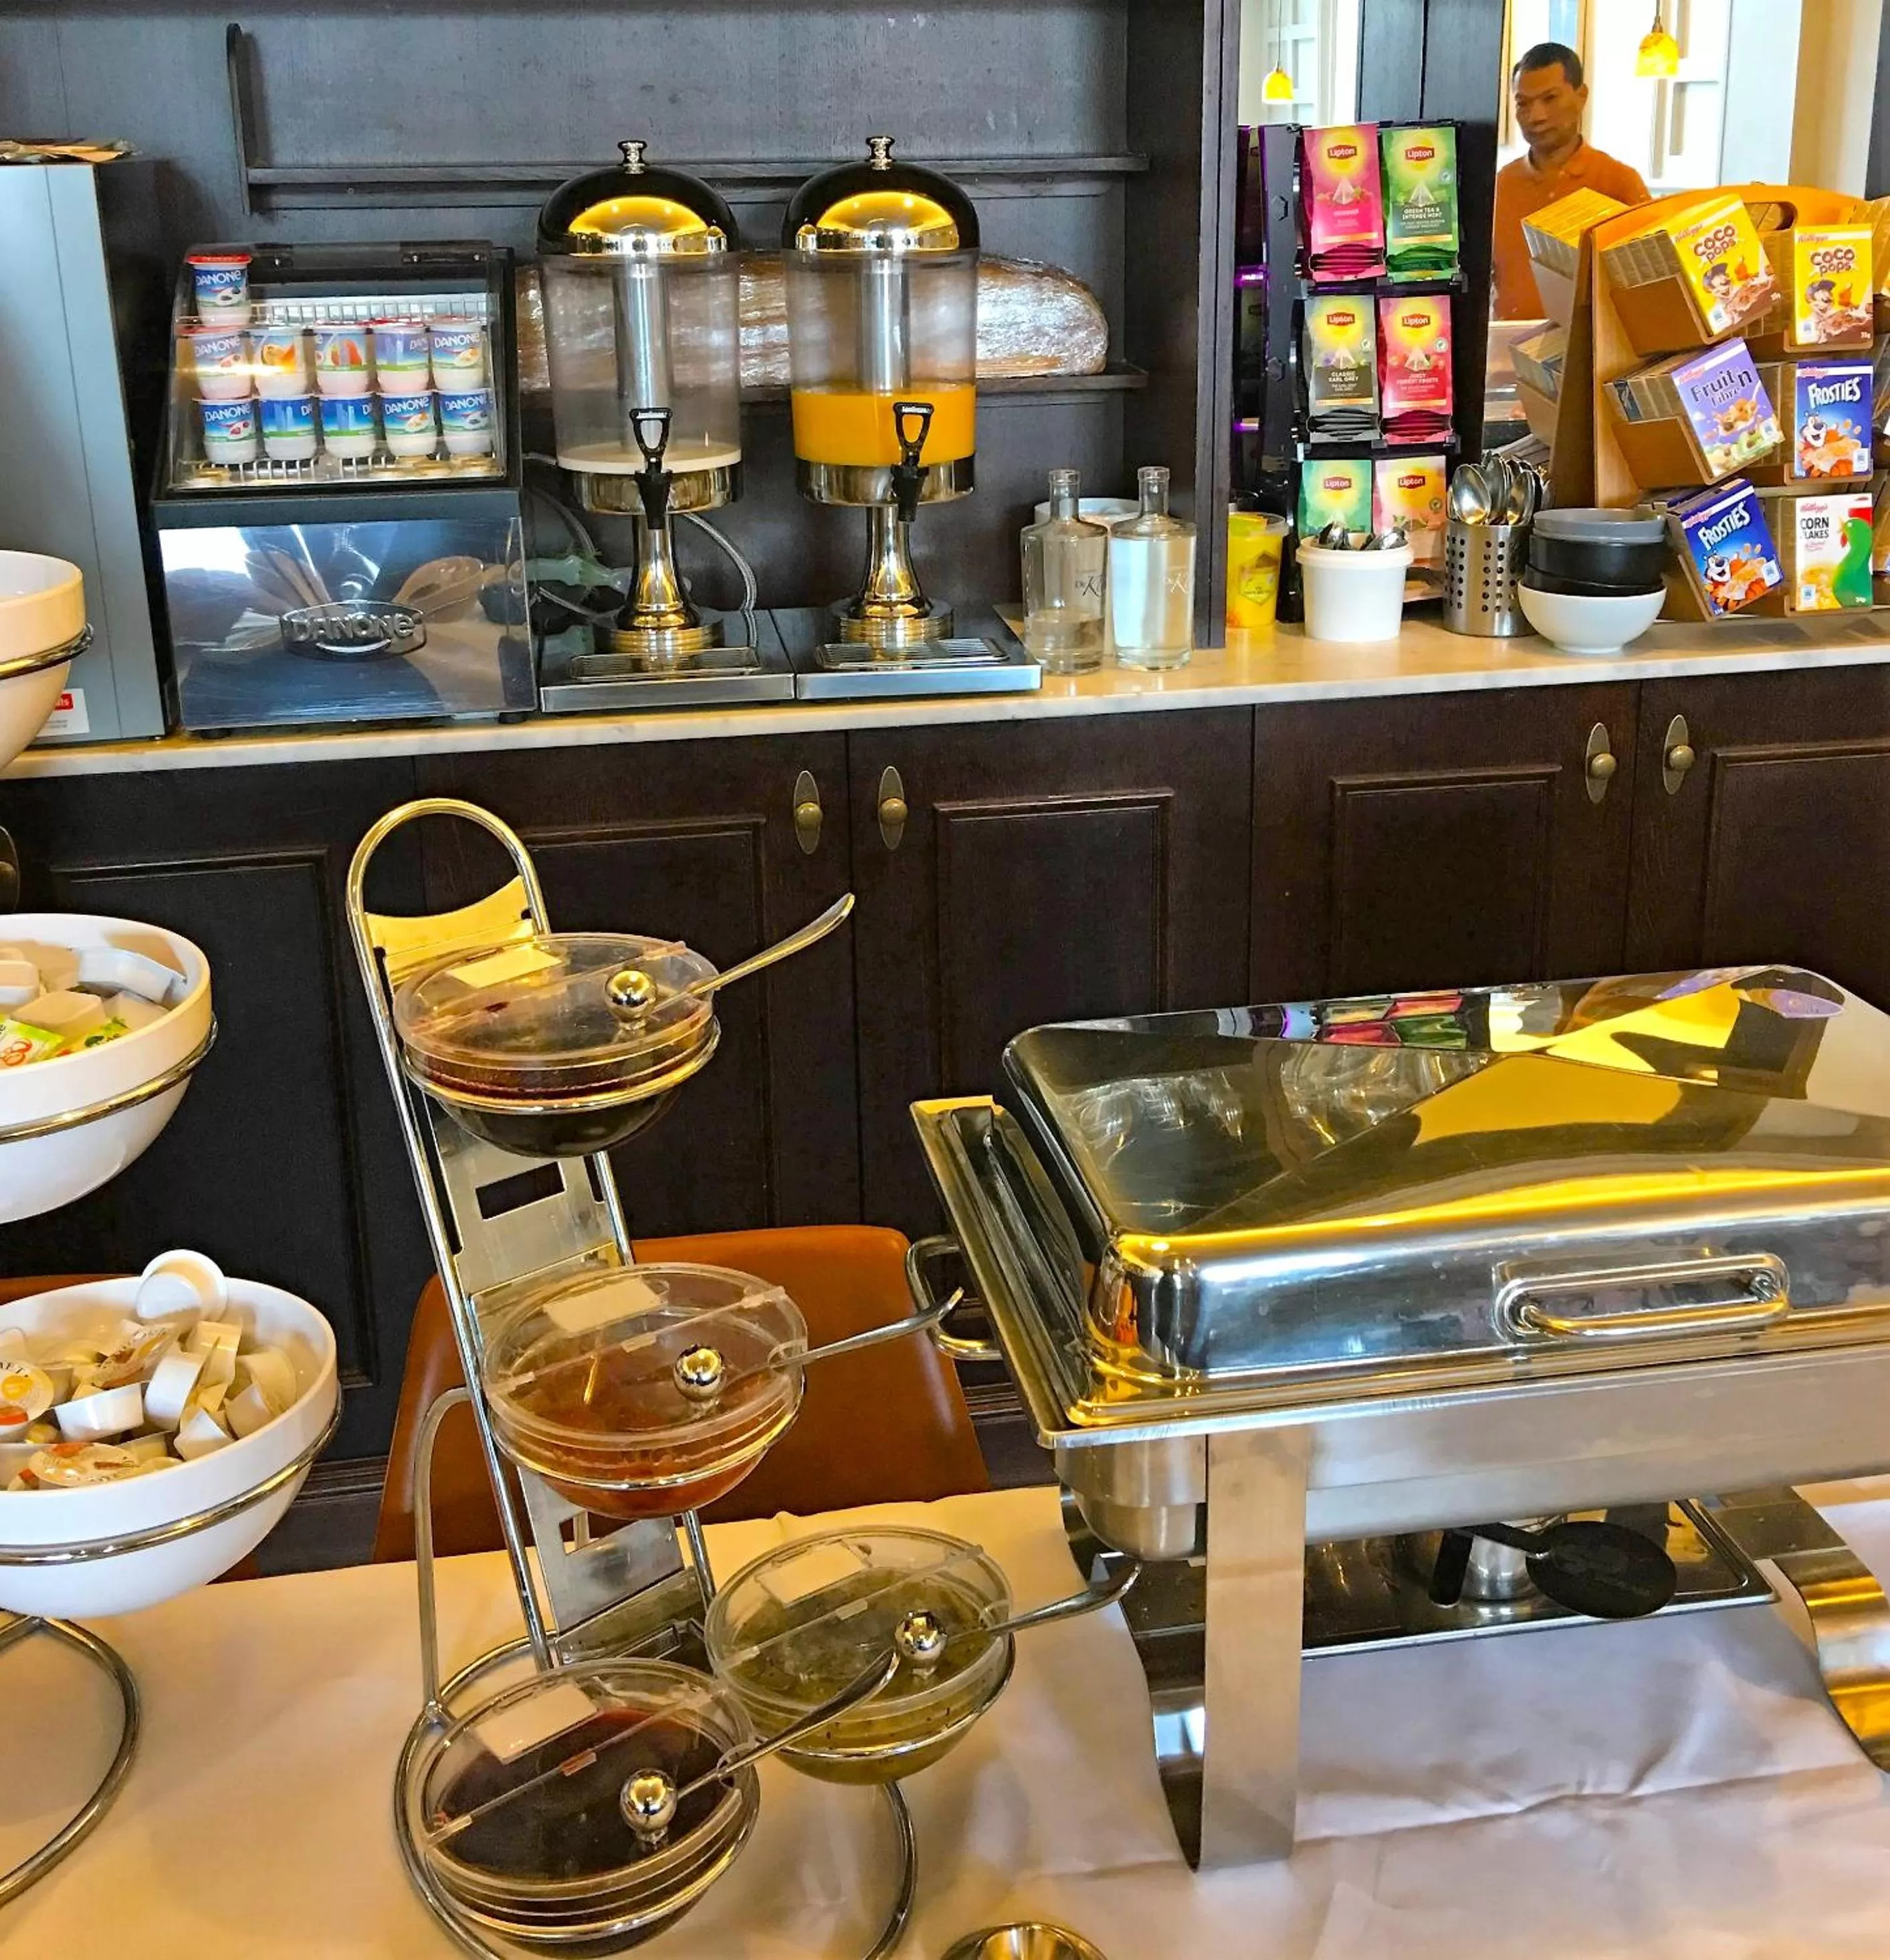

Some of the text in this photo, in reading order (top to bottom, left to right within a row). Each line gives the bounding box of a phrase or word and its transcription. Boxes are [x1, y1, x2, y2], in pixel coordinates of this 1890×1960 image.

[1329, 149, 1355, 158] Lipton
[1407, 149, 1433, 159] Lipton
[1329, 314, 1353, 324] Lipton
[1403, 316, 1429, 326] Lipton
[1691, 370, 1735, 402] Fruit
[1808, 376, 1861, 409] FROSTIES
[1325, 479, 1350, 488] Lipton
[1399, 478, 1424, 486] Lipton
[1697, 501, 1751, 551] FROSTIES
[1800, 516, 1829, 530] CORN
[1800, 529, 1829, 539] LAKES
